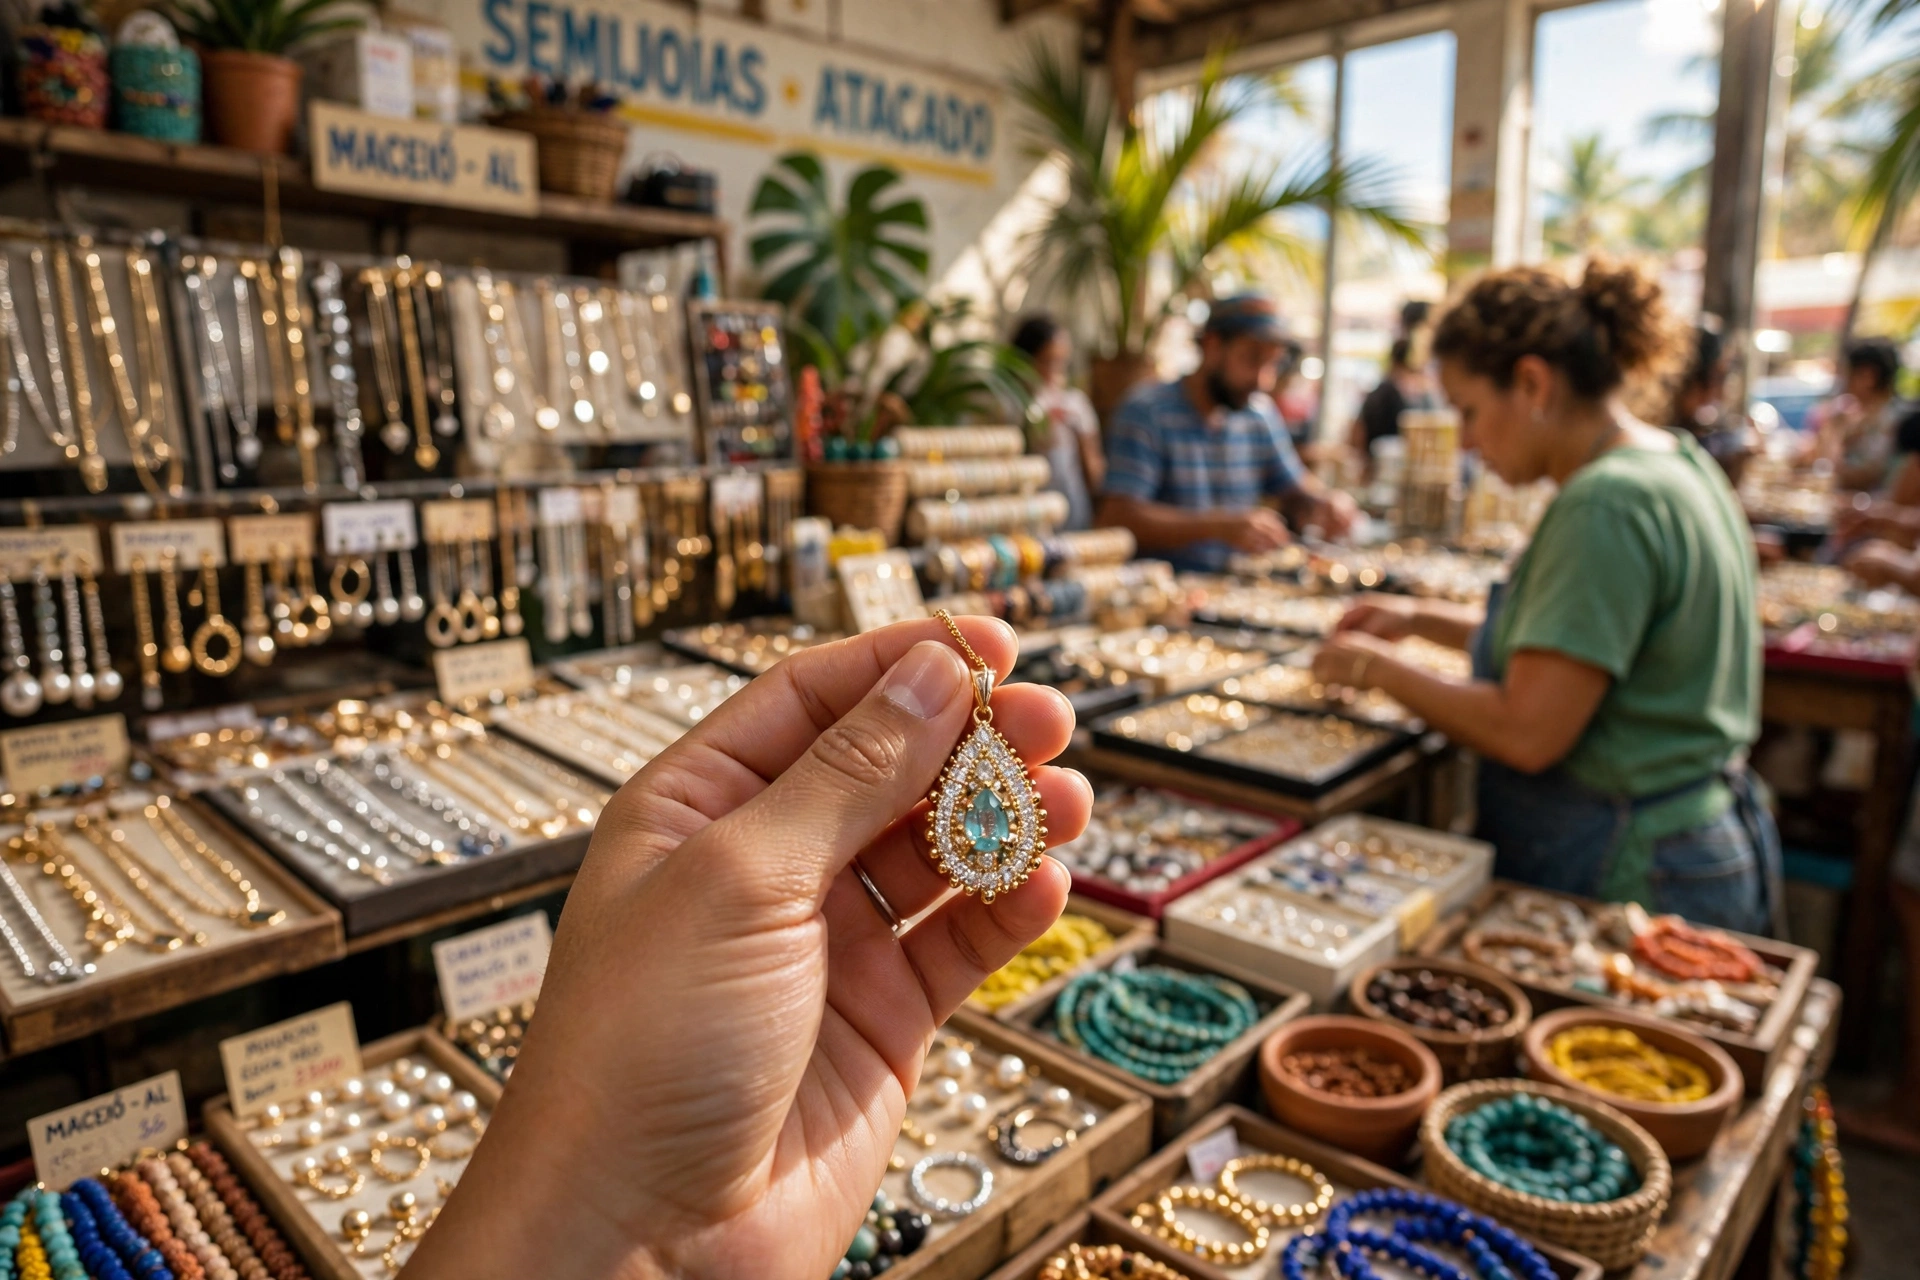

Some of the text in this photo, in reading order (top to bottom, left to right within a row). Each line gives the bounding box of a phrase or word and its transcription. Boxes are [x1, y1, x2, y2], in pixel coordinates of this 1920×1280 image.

[813, 63, 995, 159] ATACADO
[486, 150, 523, 194] AL
[45, 1091, 126, 1143] MACEIÓ
[144, 1084, 171, 1109] AL
